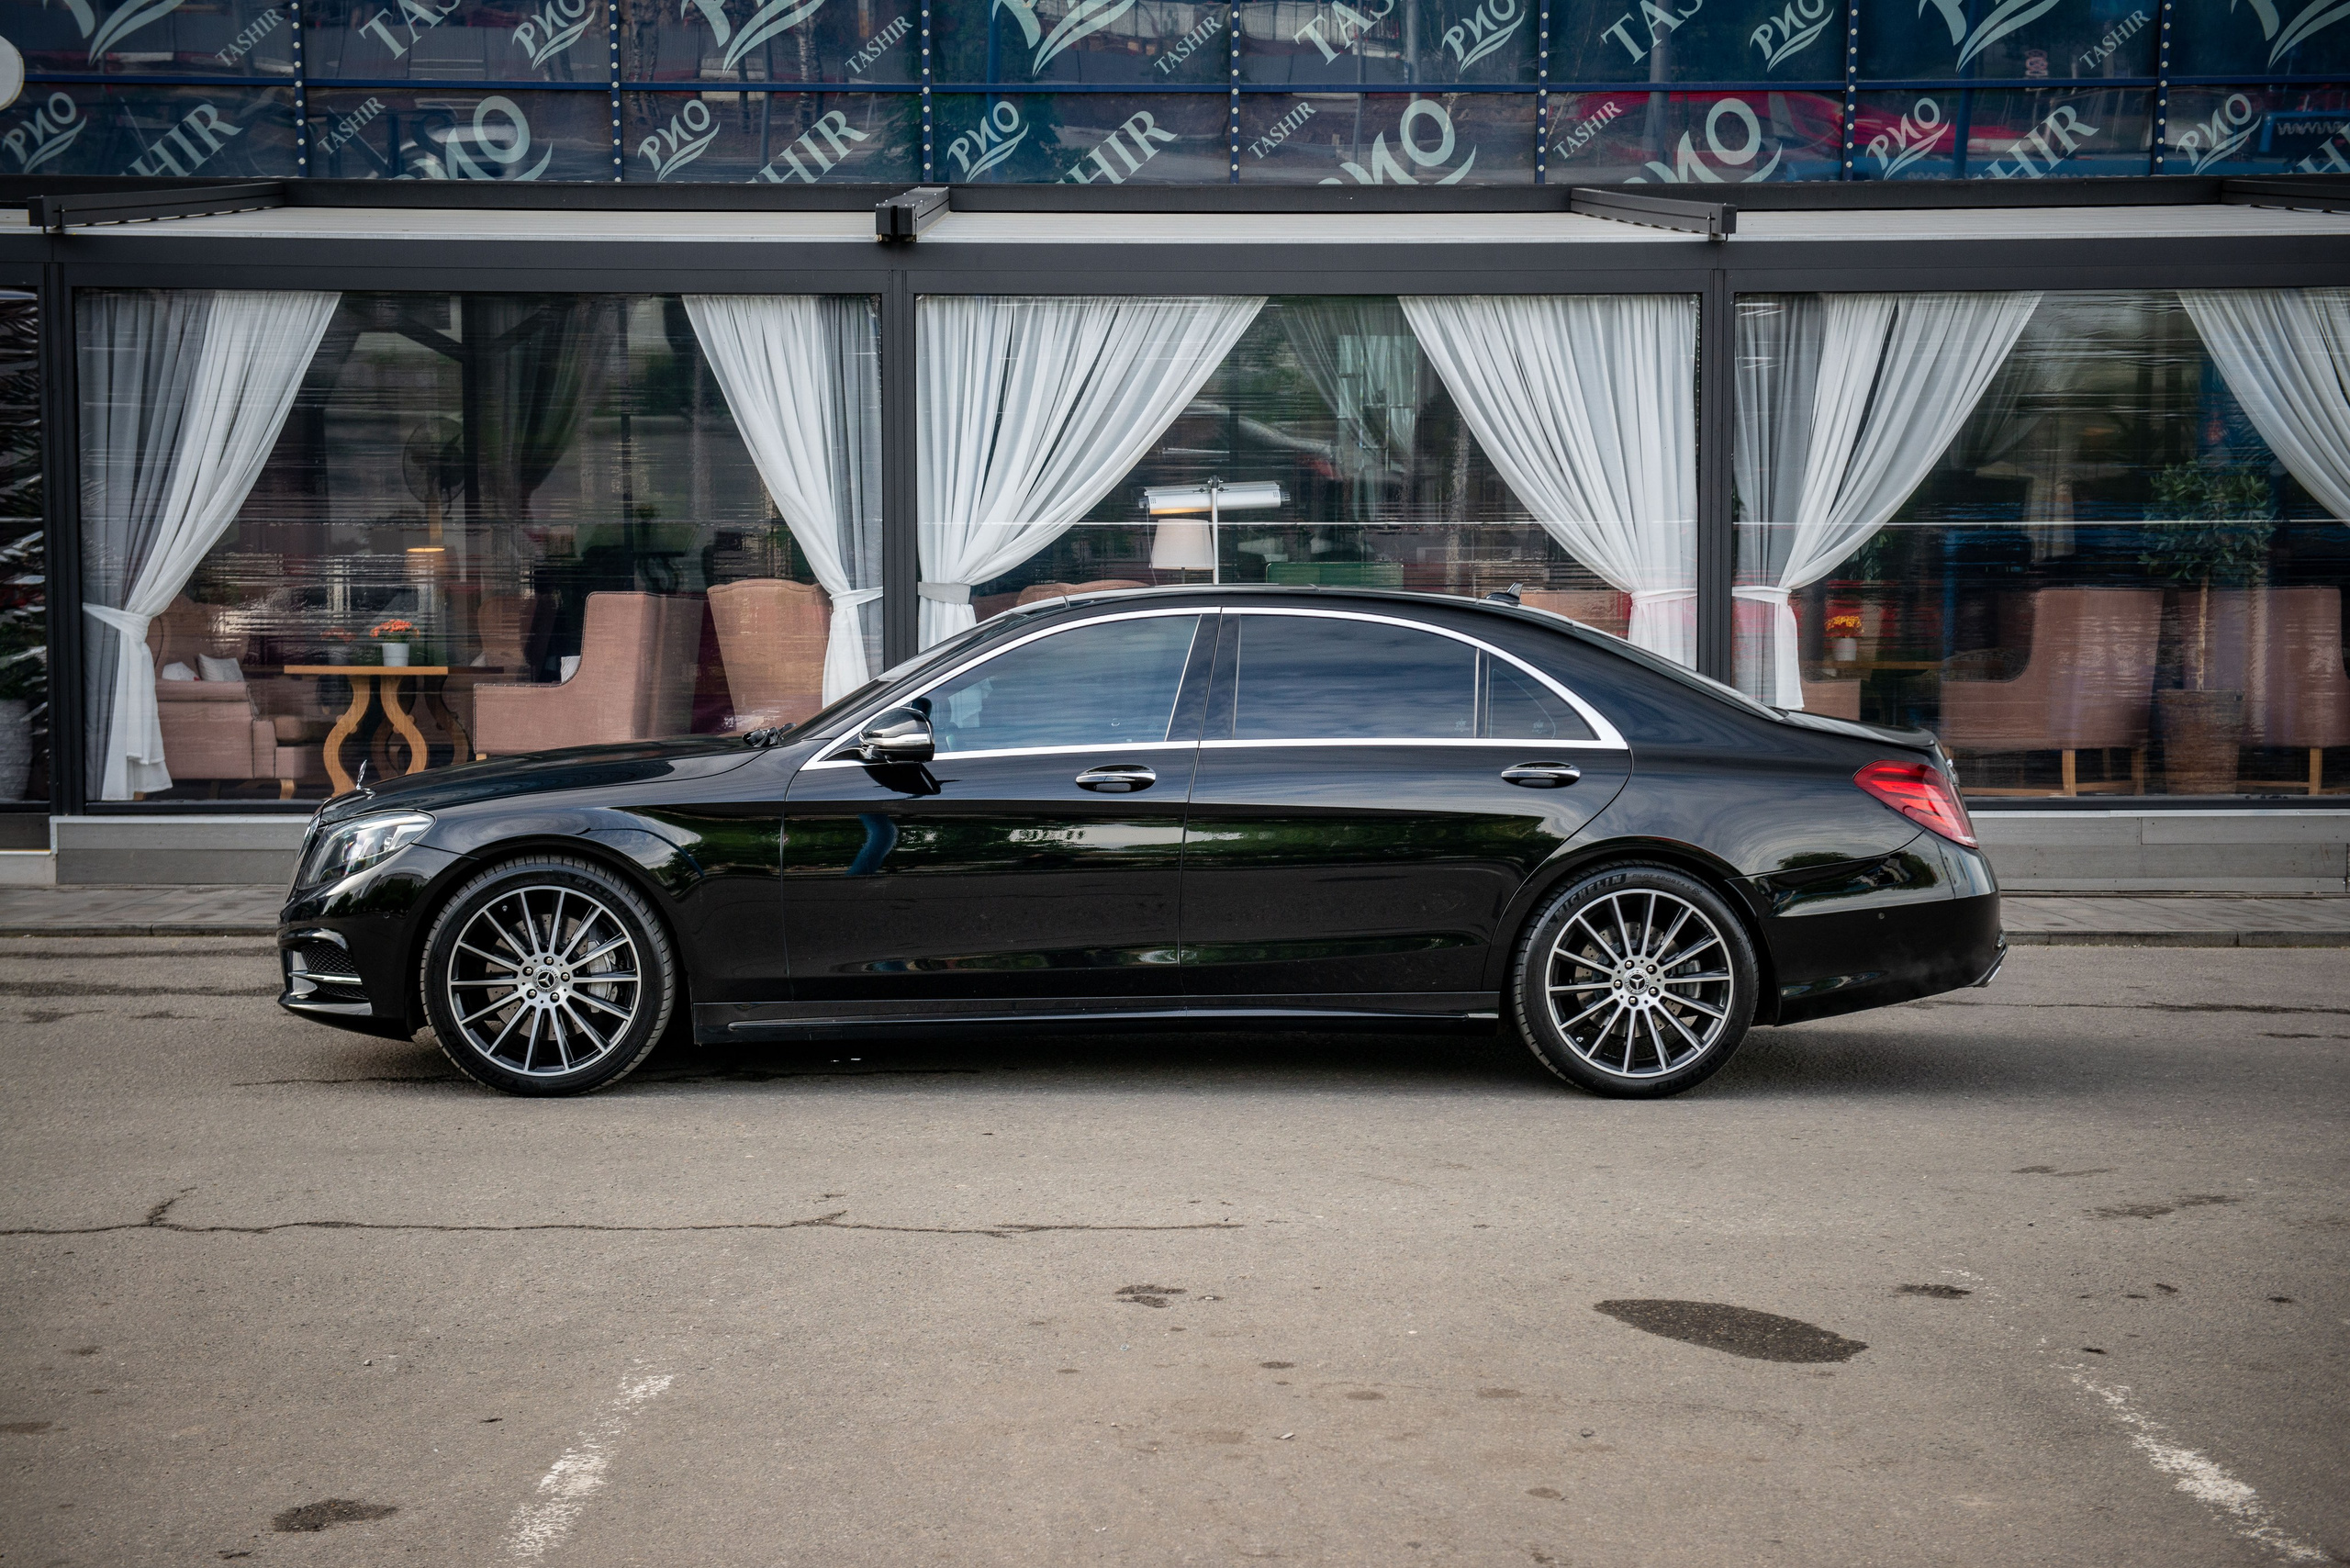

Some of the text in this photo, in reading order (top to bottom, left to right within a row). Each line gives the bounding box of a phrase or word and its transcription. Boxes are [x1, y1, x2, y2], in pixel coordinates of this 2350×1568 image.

[215, 8, 285, 68] TASHIR
[845, 16, 913, 74] TASHIR
[1154, 16, 1223, 74] TASHIR
[2079, 9, 2151, 70] TASHIR
[122, 104, 243, 176] HIR
[318, 96, 386, 155] TASHIR
[745, 110, 871, 183] HIR
[1057, 110, 1178, 184] HIR
[1248, 101, 1316, 160] TASHIR
[1552, 100, 1622, 160] TASHIR
[1974, 106, 2100, 179] HIR
[1554, 874, 1622, 918] MICHELIN
[1655, 875, 1681, 886] SPORT
